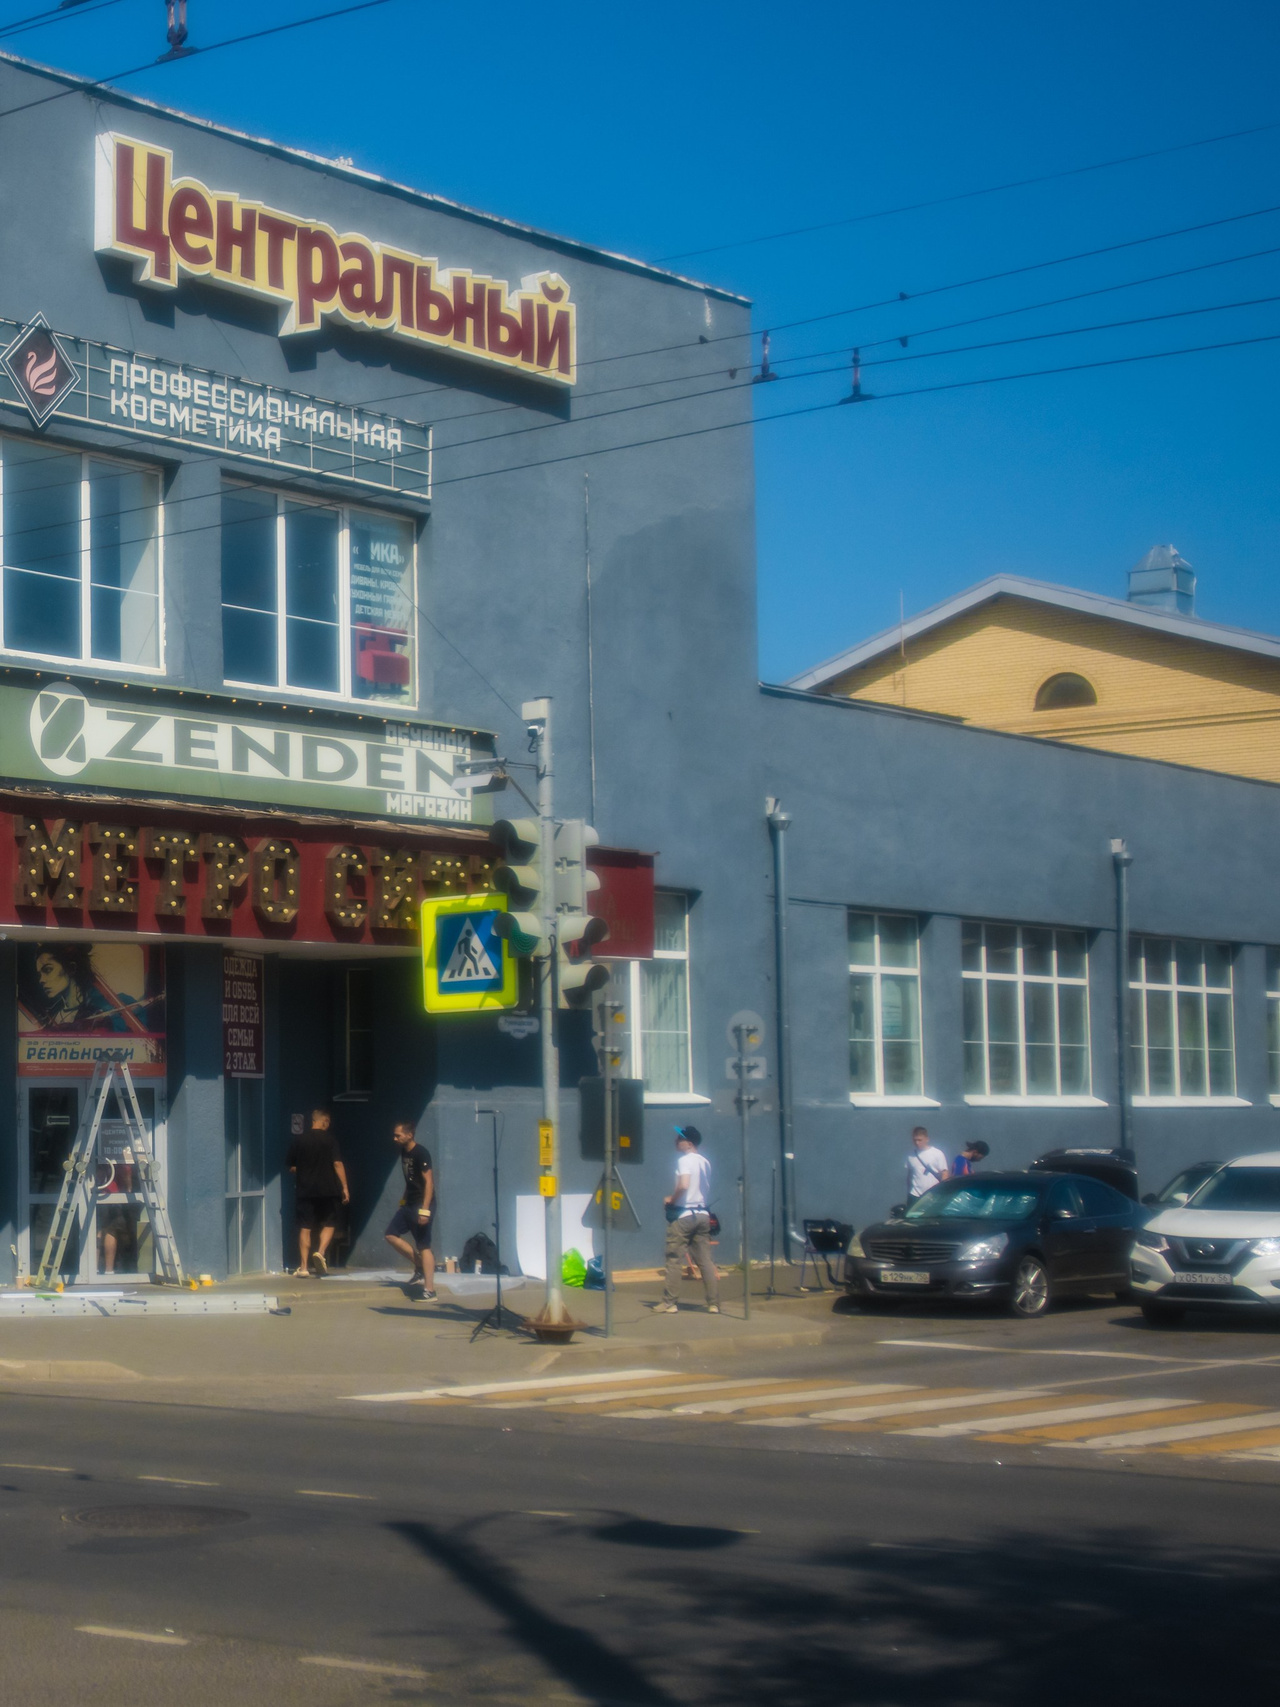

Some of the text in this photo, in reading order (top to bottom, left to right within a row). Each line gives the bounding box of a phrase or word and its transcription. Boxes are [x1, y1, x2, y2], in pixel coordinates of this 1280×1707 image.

[115, 141, 572, 376] Центральный
[109, 358, 402, 453] ПРОФЕССИОНАЛЬНАЯ
[110, 388, 282, 453] КОСМЕТИКА
[105, 709, 467, 798] ZENDEN
[385, 724, 471, 754] ОБУВНОЙ
[386, 792, 473, 822] МАГАЗИН
[14, 814, 301, 926] МЕТРО
[223, 956, 258, 978] ОДЕЖДА
[224, 980, 257, 1001] И ОБУВЬ
[222, 1003, 260, 1024] ДЛЯ ВСЕЙ
[228, 1028, 255, 1047] СЕМЬИ
[226, 1052, 257, 1070] 2 ЭТАЖ
